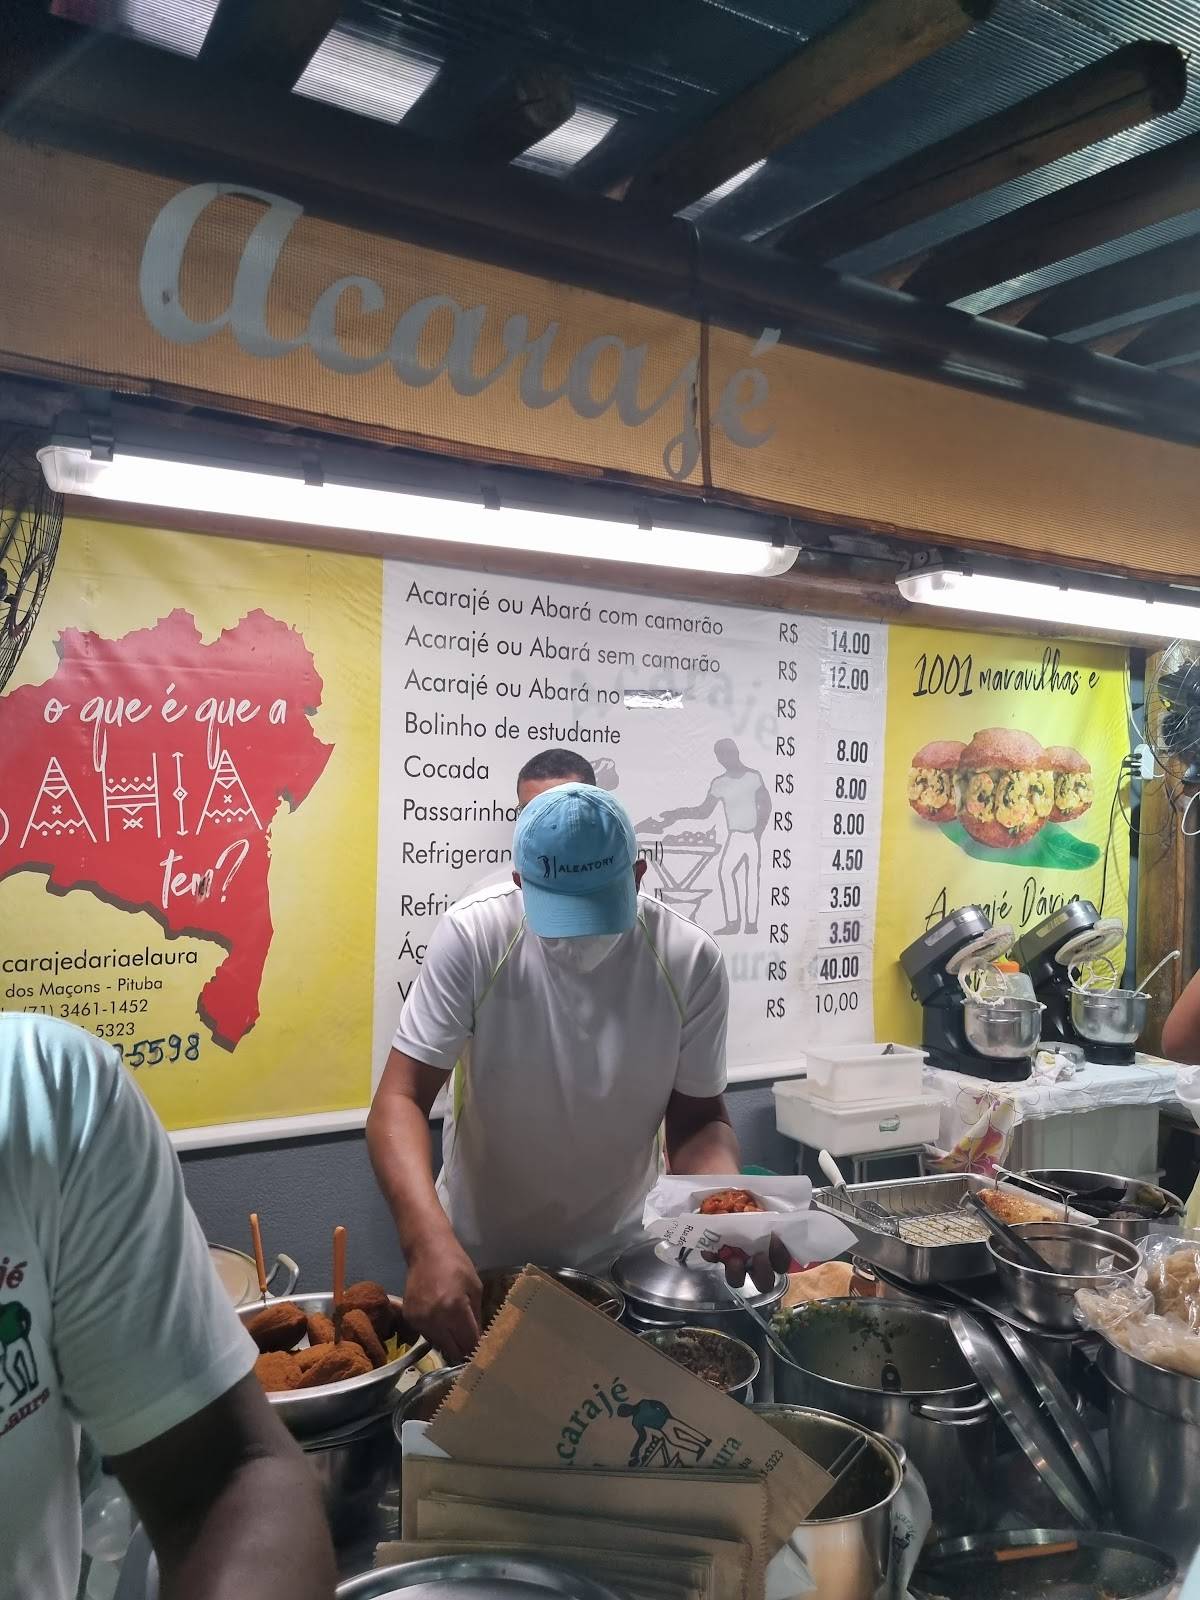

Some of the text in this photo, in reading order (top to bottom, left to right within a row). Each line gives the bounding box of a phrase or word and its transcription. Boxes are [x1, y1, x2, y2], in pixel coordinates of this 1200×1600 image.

[140, 181, 781, 480] Acarajé
[404, 581, 870, 655] Acarajé ou Abará com camarão R$ 14.00
[404, 626, 869, 691] Acarajé ou Abará sem camarão R$ 12.00
[913, 646, 1100, 697] 1001 maravilhas e
[404, 669, 797, 719] Acarajé ou Abará no R$
[44, 682, 287, 772] o que é que a
[405, 711, 868, 764] Bolinho de estudante R$ 8.00
[0, 750, 263, 848] AHIA
[403, 755, 867, 801] Cocada R$ 8.00
[402, 798, 865, 836] Passarinha R$ 8.00
[160, 839, 250, 909] tem?
[401, 842, 512, 867] Refrigeran
[771, 848, 792, 870] R$
[832, 849, 863, 872] 4.50
[558, 856, 614, 873] ALEATORY
[401, 885, 861, 916] Refri R$ 3.50
[2, 947, 198, 975] carajedariaelaura
[398, 920, 861, 964] Ág R$ 3.50
[5, 983, 34, 998] dos
[39, 981, 101, 998] Maçons
[118, 977, 163, 992] Pituba
[767, 960, 788, 981] R$
[819, 955, 859, 981] 40.00
[60, 999, 148, 1017] 3461-1452
[766, 992, 859, 1019] R$ 10,00
[93, 1022, 135, 1037] 5323
[556, 1376, 631, 1465] carajé
